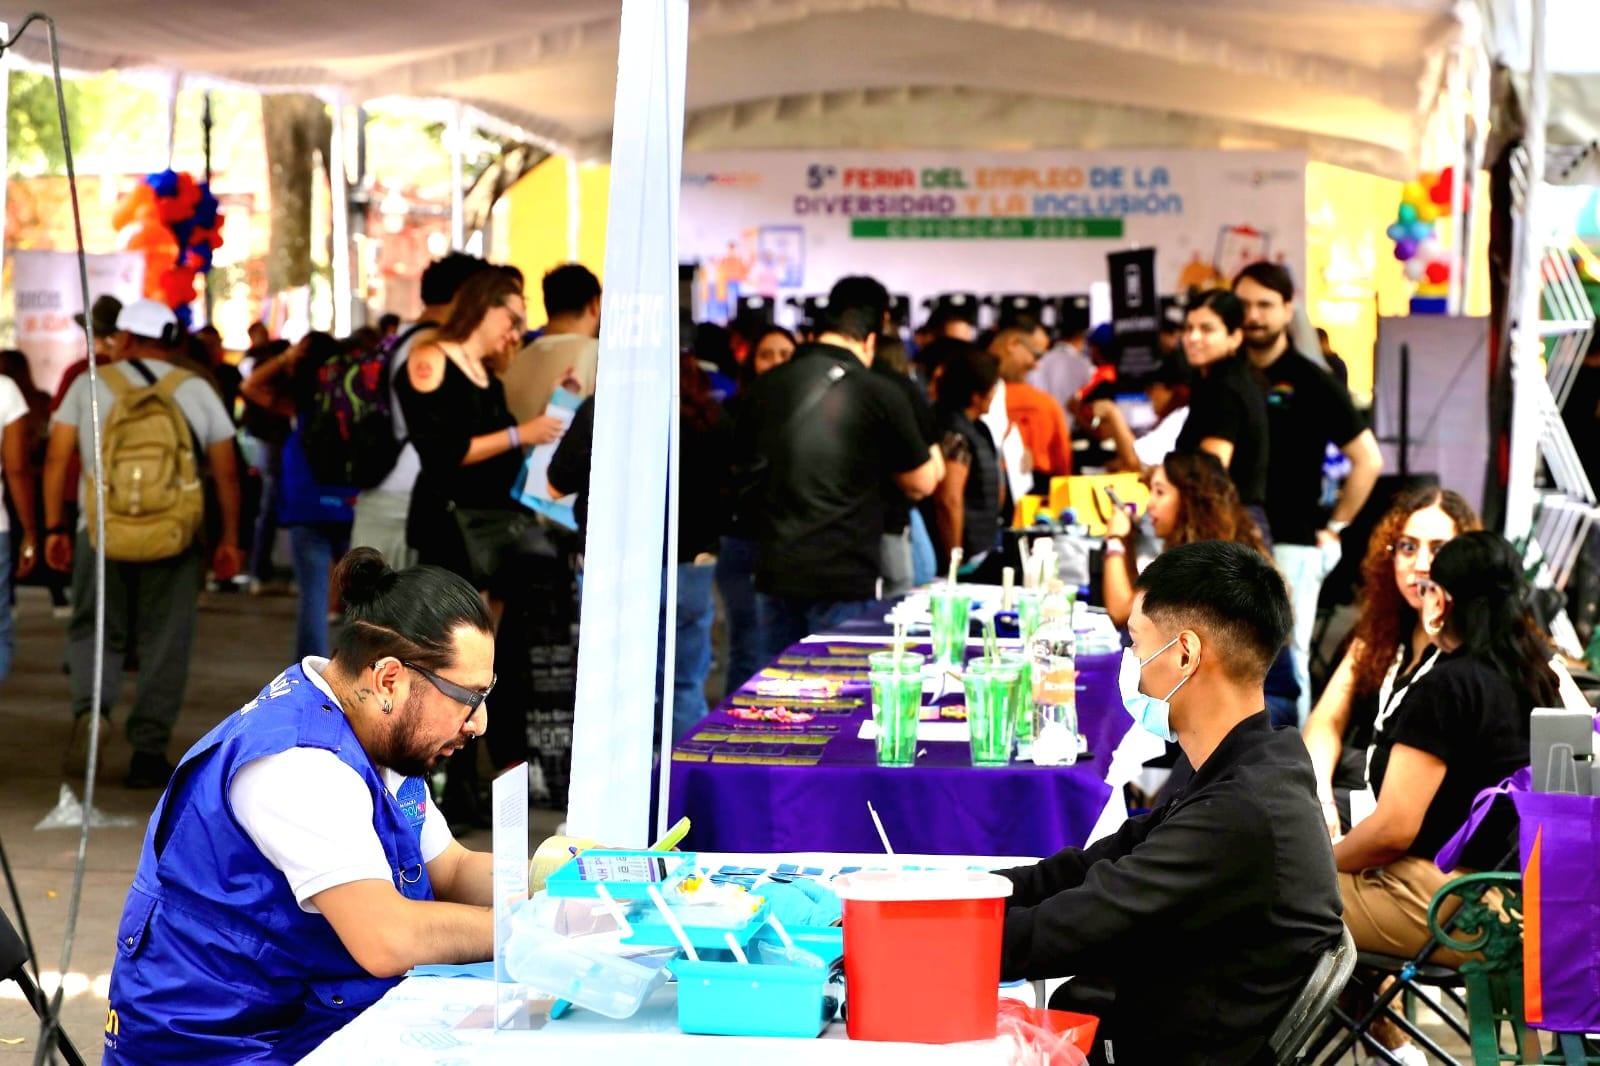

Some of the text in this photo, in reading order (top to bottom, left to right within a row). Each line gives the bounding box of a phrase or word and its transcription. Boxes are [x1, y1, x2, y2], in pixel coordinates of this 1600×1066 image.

[843, 167, 915, 188] FERIA
[921, 167, 968, 188] DEL
[976, 167, 1084, 190] EMPLEO
[1090, 167, 1124, 188] DE
[1134, 166, 1168, 188] LA
[794, 192, 1182, 216] DIVERSIDAD Y LA INCLUSIÓN
